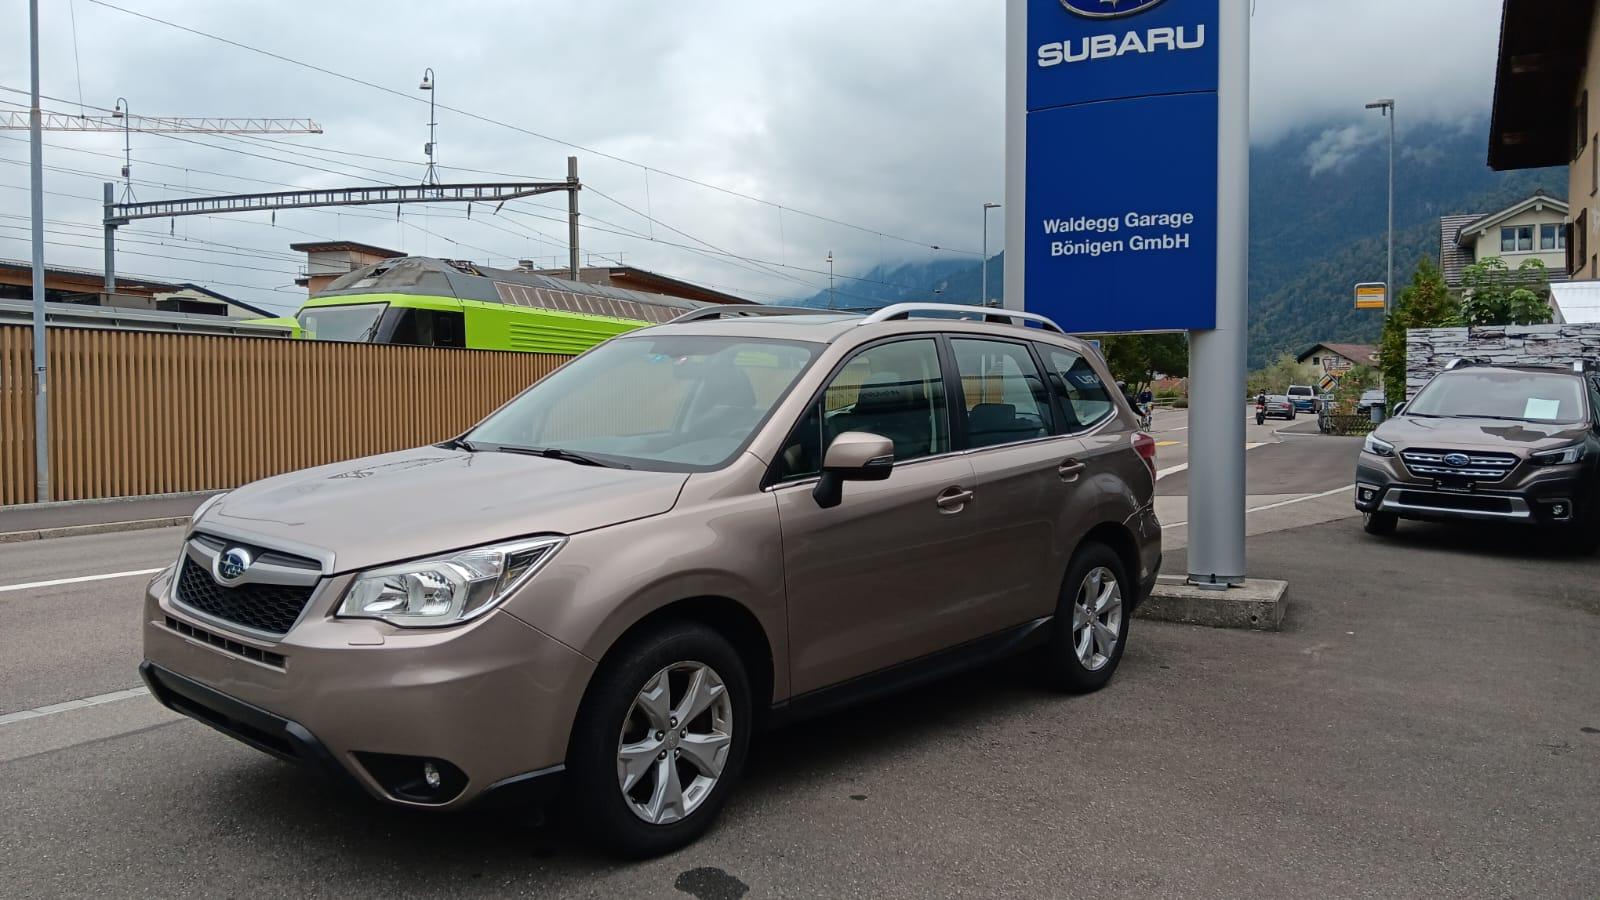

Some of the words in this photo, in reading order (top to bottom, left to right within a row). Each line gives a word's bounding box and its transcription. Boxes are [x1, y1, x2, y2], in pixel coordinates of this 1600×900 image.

[1037, 24, 1205, 67] SUBARU
[1043, 216, 1119, 234] Waldegg
[1124, 212, 1194, 228] Garage
[1051, 239, 1124, 257] Bönigen
[1129, 233, 1190, 251] GmbH
